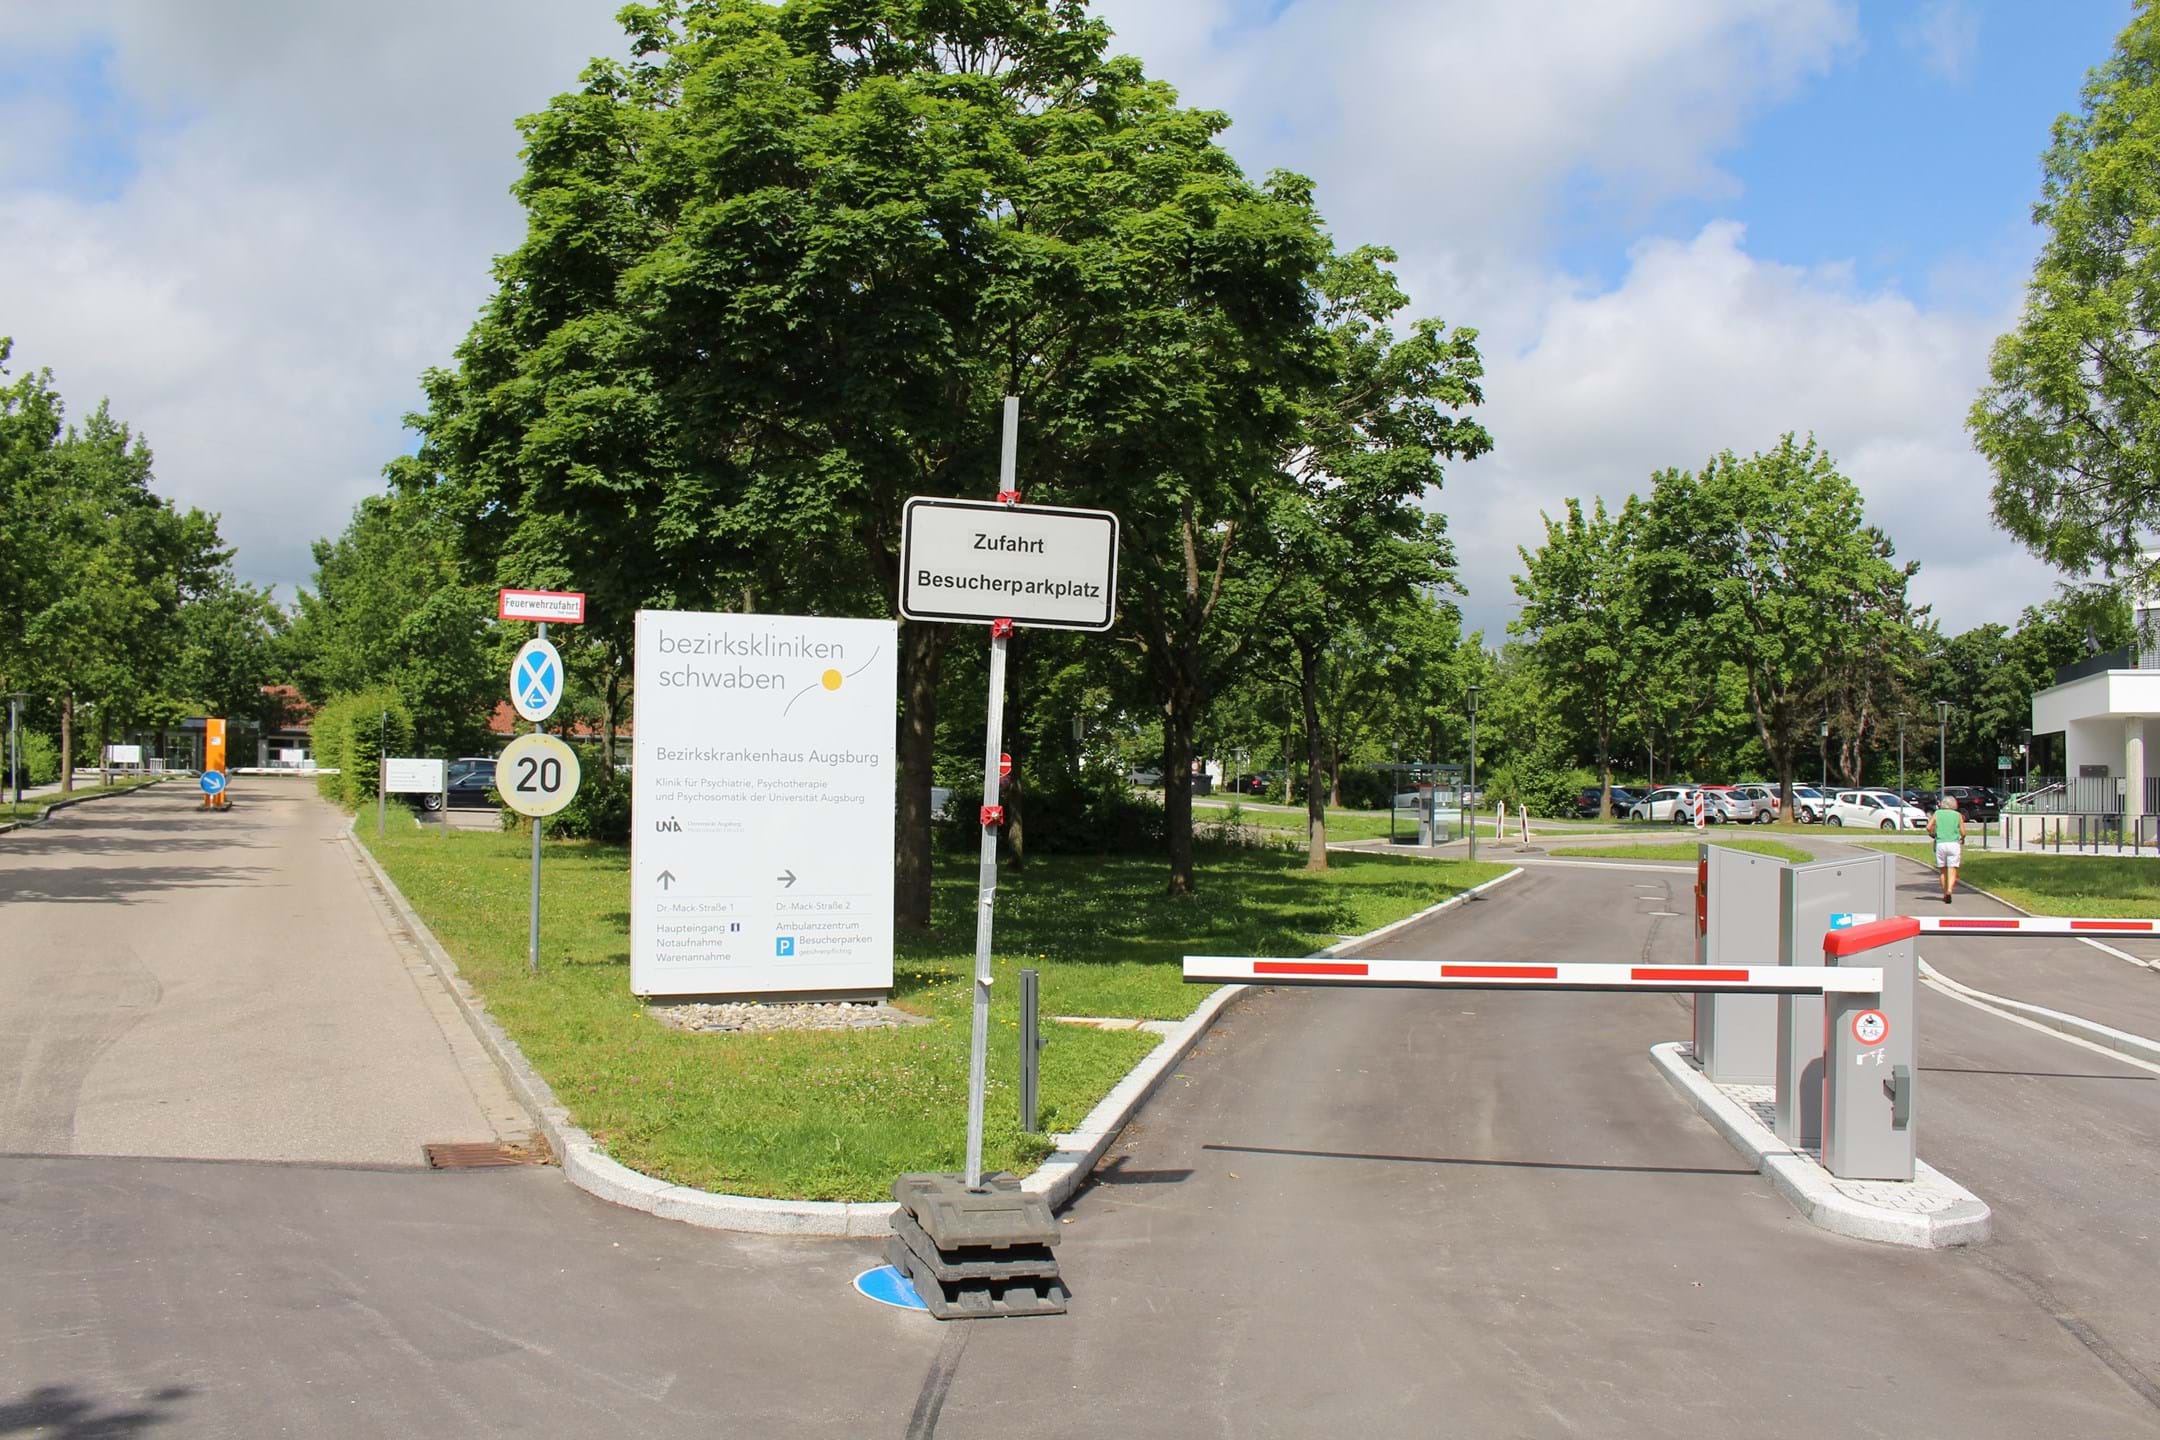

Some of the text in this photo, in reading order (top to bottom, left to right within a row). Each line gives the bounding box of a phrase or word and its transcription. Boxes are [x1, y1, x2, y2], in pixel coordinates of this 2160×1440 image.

[973, 532, 1044, 553] Zufahrt
[917, 570, 1100, 599] Besucherparkplatz
[505, 597, 579, 611] Feuerwehrzufahrt
[658, 628, 844, 659] bezirkskliniken
[658, 663, 785, 690] schwaben
[656, 747, 879, 767] Bezirkskrankenhaus Augsburg
[516, 757, 561, 793] 20
[655, 777, 828, 790] Klinik für Psychiatrie, Psychotherapie
[655, 791, 865, 805] und Psychosomatik der Universität Augsburg
[656, 903, 735, 913] Dr.-Mack-Straße 1
[776, 901, 852, 911] Dr.-Mack-Straße 2
[656, 923, 726, 935] Haupteingang
[776, 920, 860, 931] Ambulanzzentrum
[656, 937, 723, 948] Notaufnahme
[780, 935, 873, 955] P Besucherparken
[656, 951, 731, 962] Warenannahme
